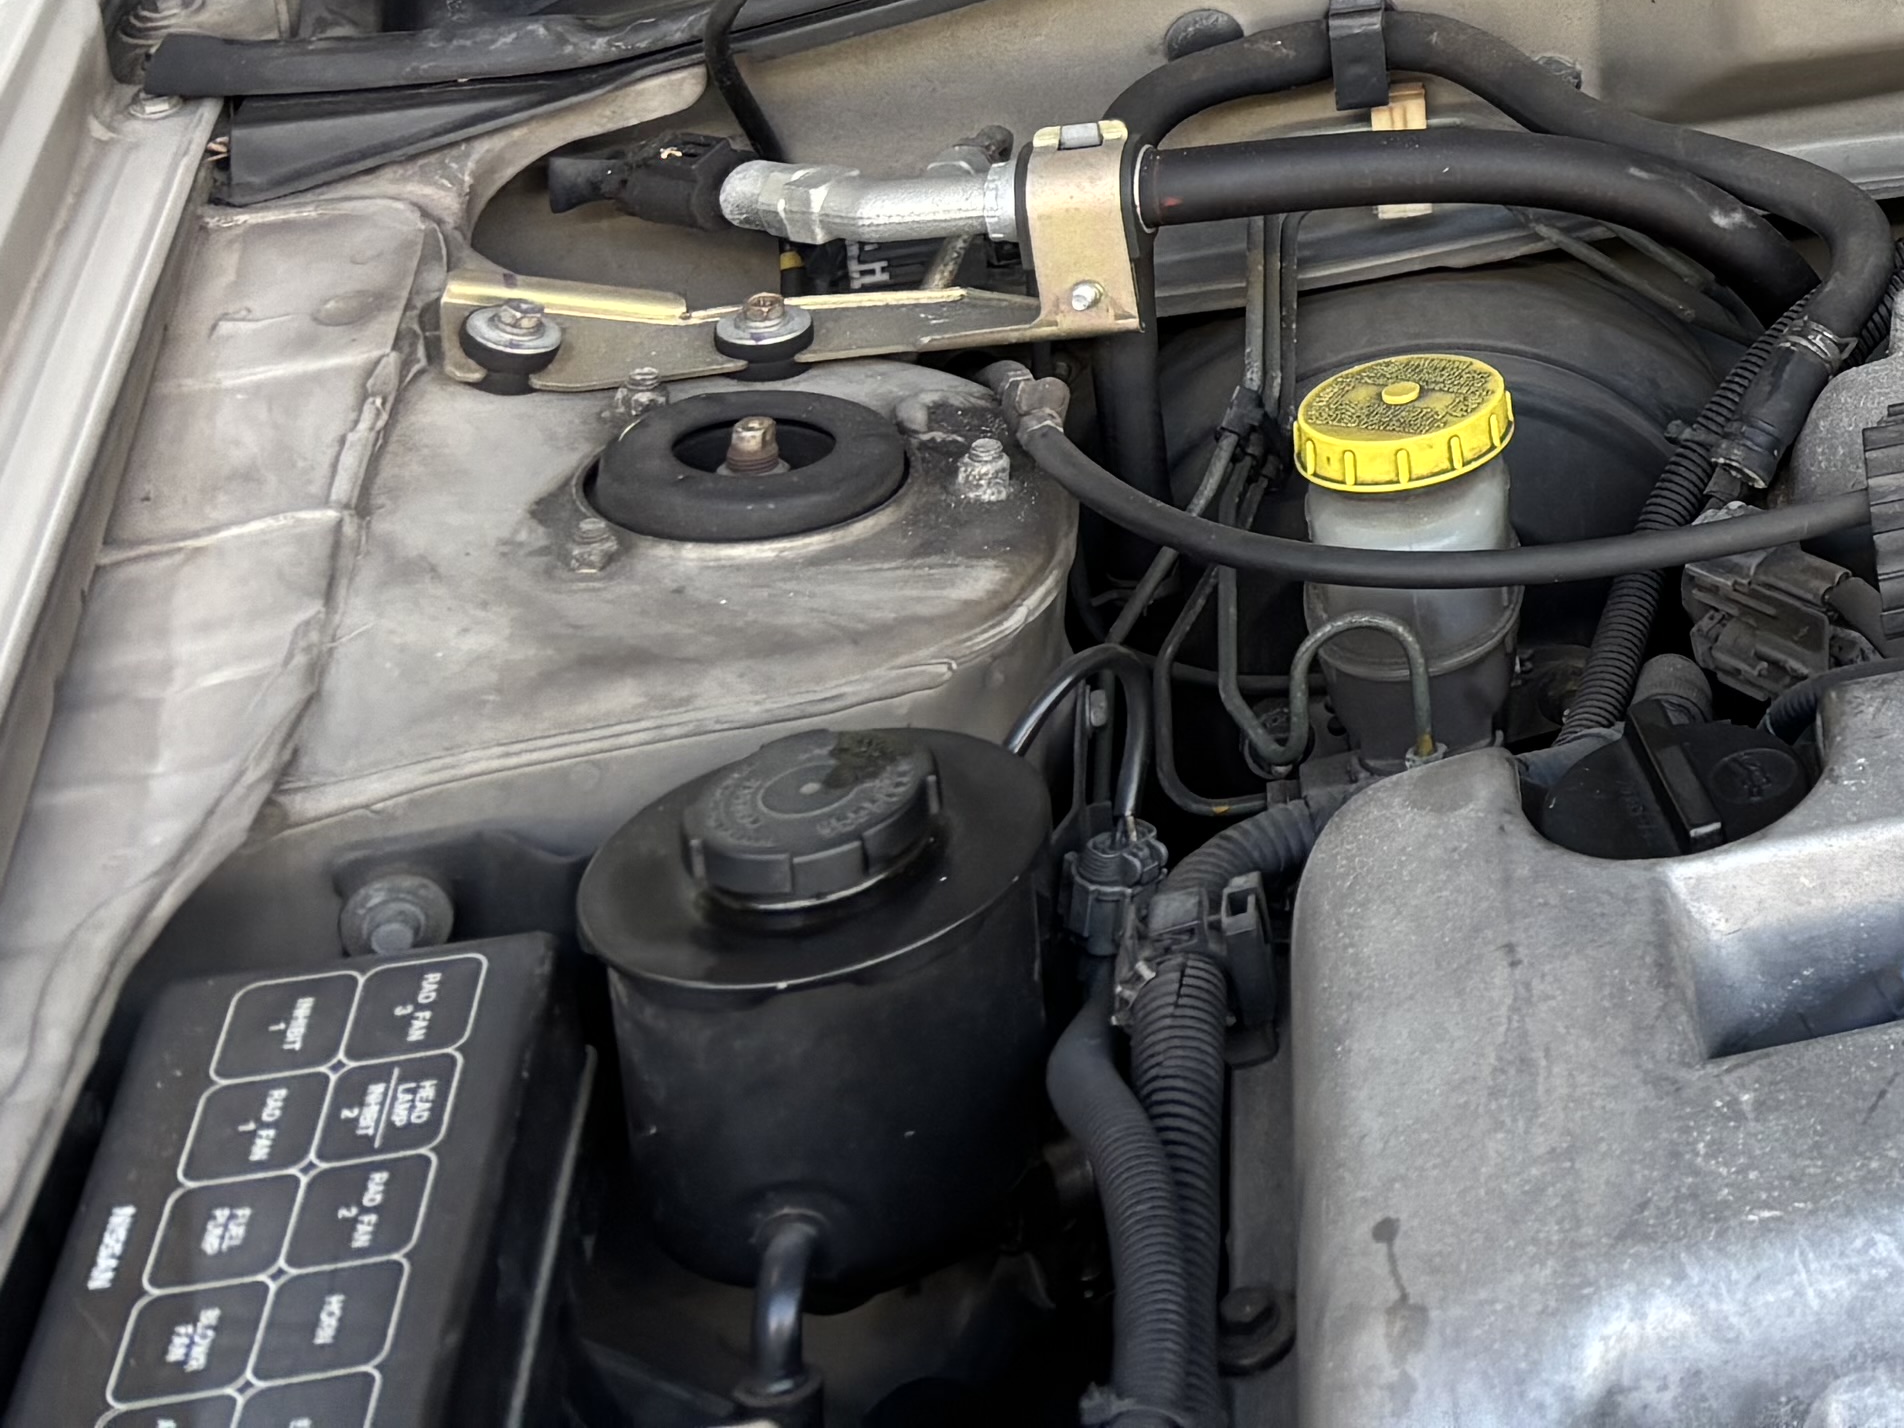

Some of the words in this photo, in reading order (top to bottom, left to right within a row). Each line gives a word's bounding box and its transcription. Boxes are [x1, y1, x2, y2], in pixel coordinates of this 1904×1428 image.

[417, 972, 443, 1004] RAD
[393, 1004, 414, 1017] 3
[406, 1010, 433, 1042] FAN
[261, 1088, 289, 1122] RAD
[340, 1107, 359, 1120] 2
[410, 1079, 438, 1124] HEAD
[248, 1128, 277, 1161] FAN
[362, 1170, 390, 1208] RAD
[337, 1206, 359, 1220] 2
[350, 1213, 379, 1249] FAN
[313, 1293, 345, 1346] HORN
